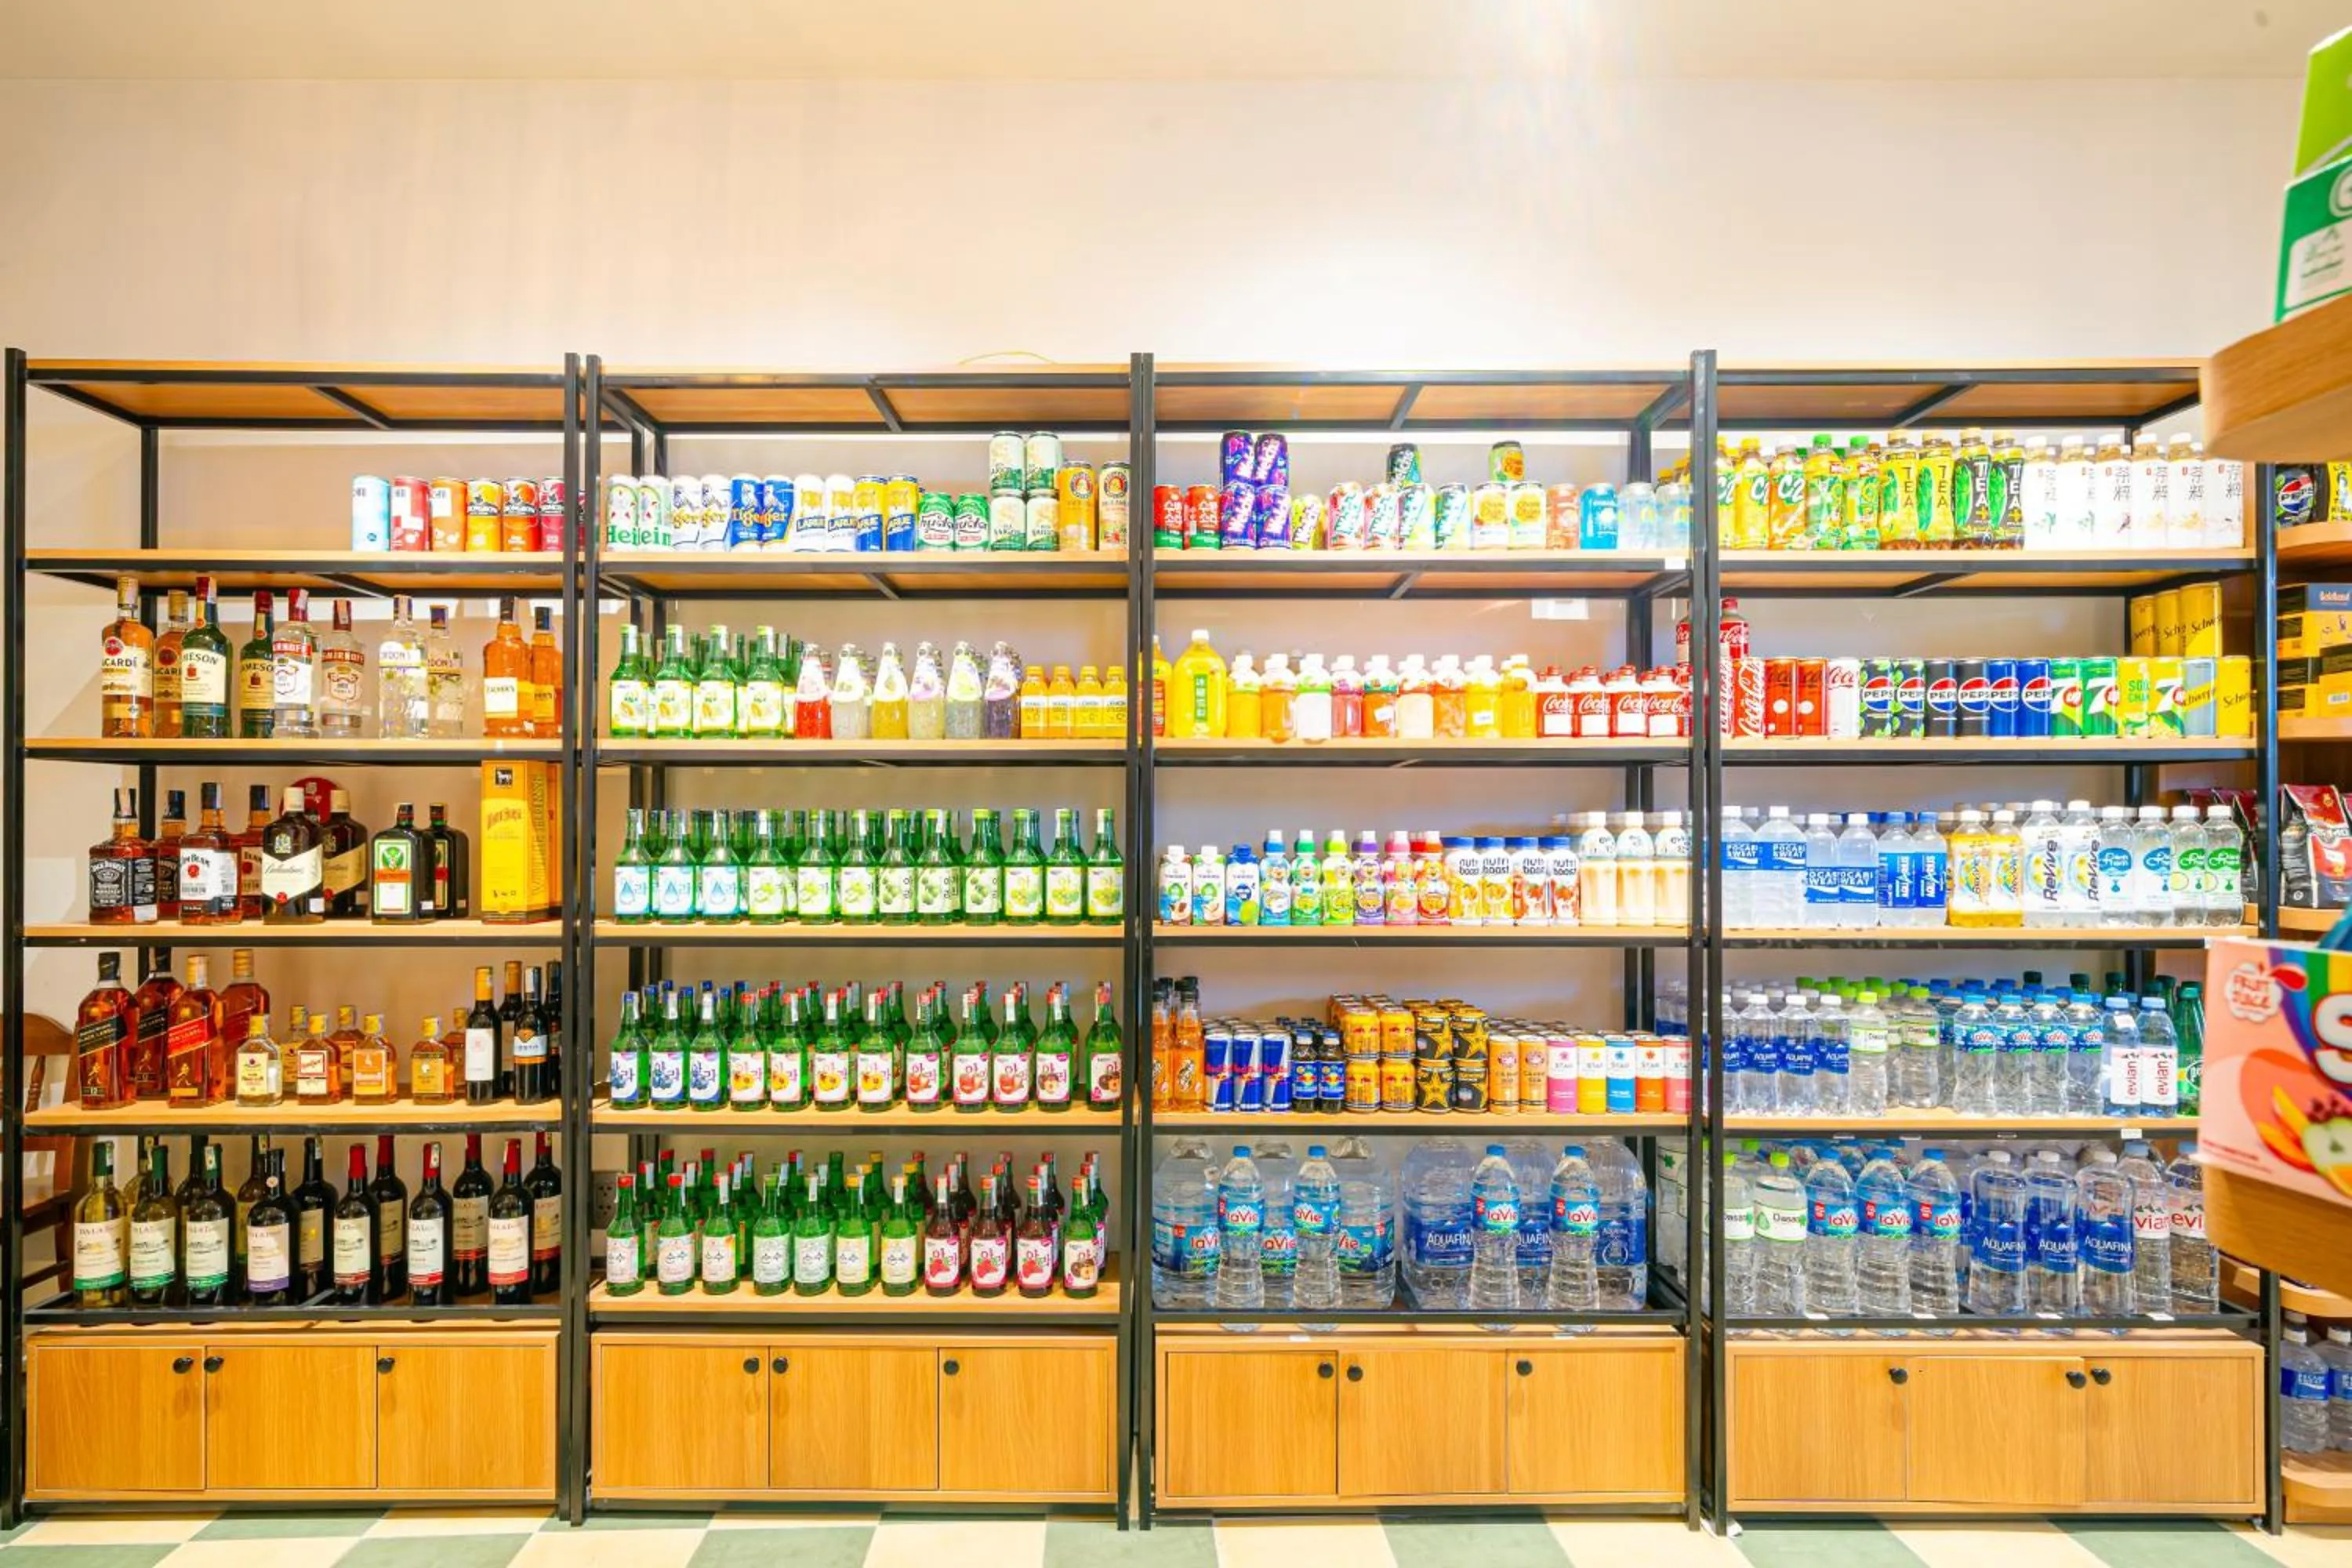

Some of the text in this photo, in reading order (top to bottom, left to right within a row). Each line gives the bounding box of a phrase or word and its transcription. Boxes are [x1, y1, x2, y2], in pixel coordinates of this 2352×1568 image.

[1777, 474, 1804, 503] C2
[1295, 1208, 1323, 1223] aVie
[2171, 1212, 2203, 1230] evi
[1191, 1234, 1218, 1249] laVi
[1261, 1236, 1297, 1250] aVie
[1338, 1234, 1359, 1249] Vie
[1426, 1232, 1473, 1247] AQUAFIN
